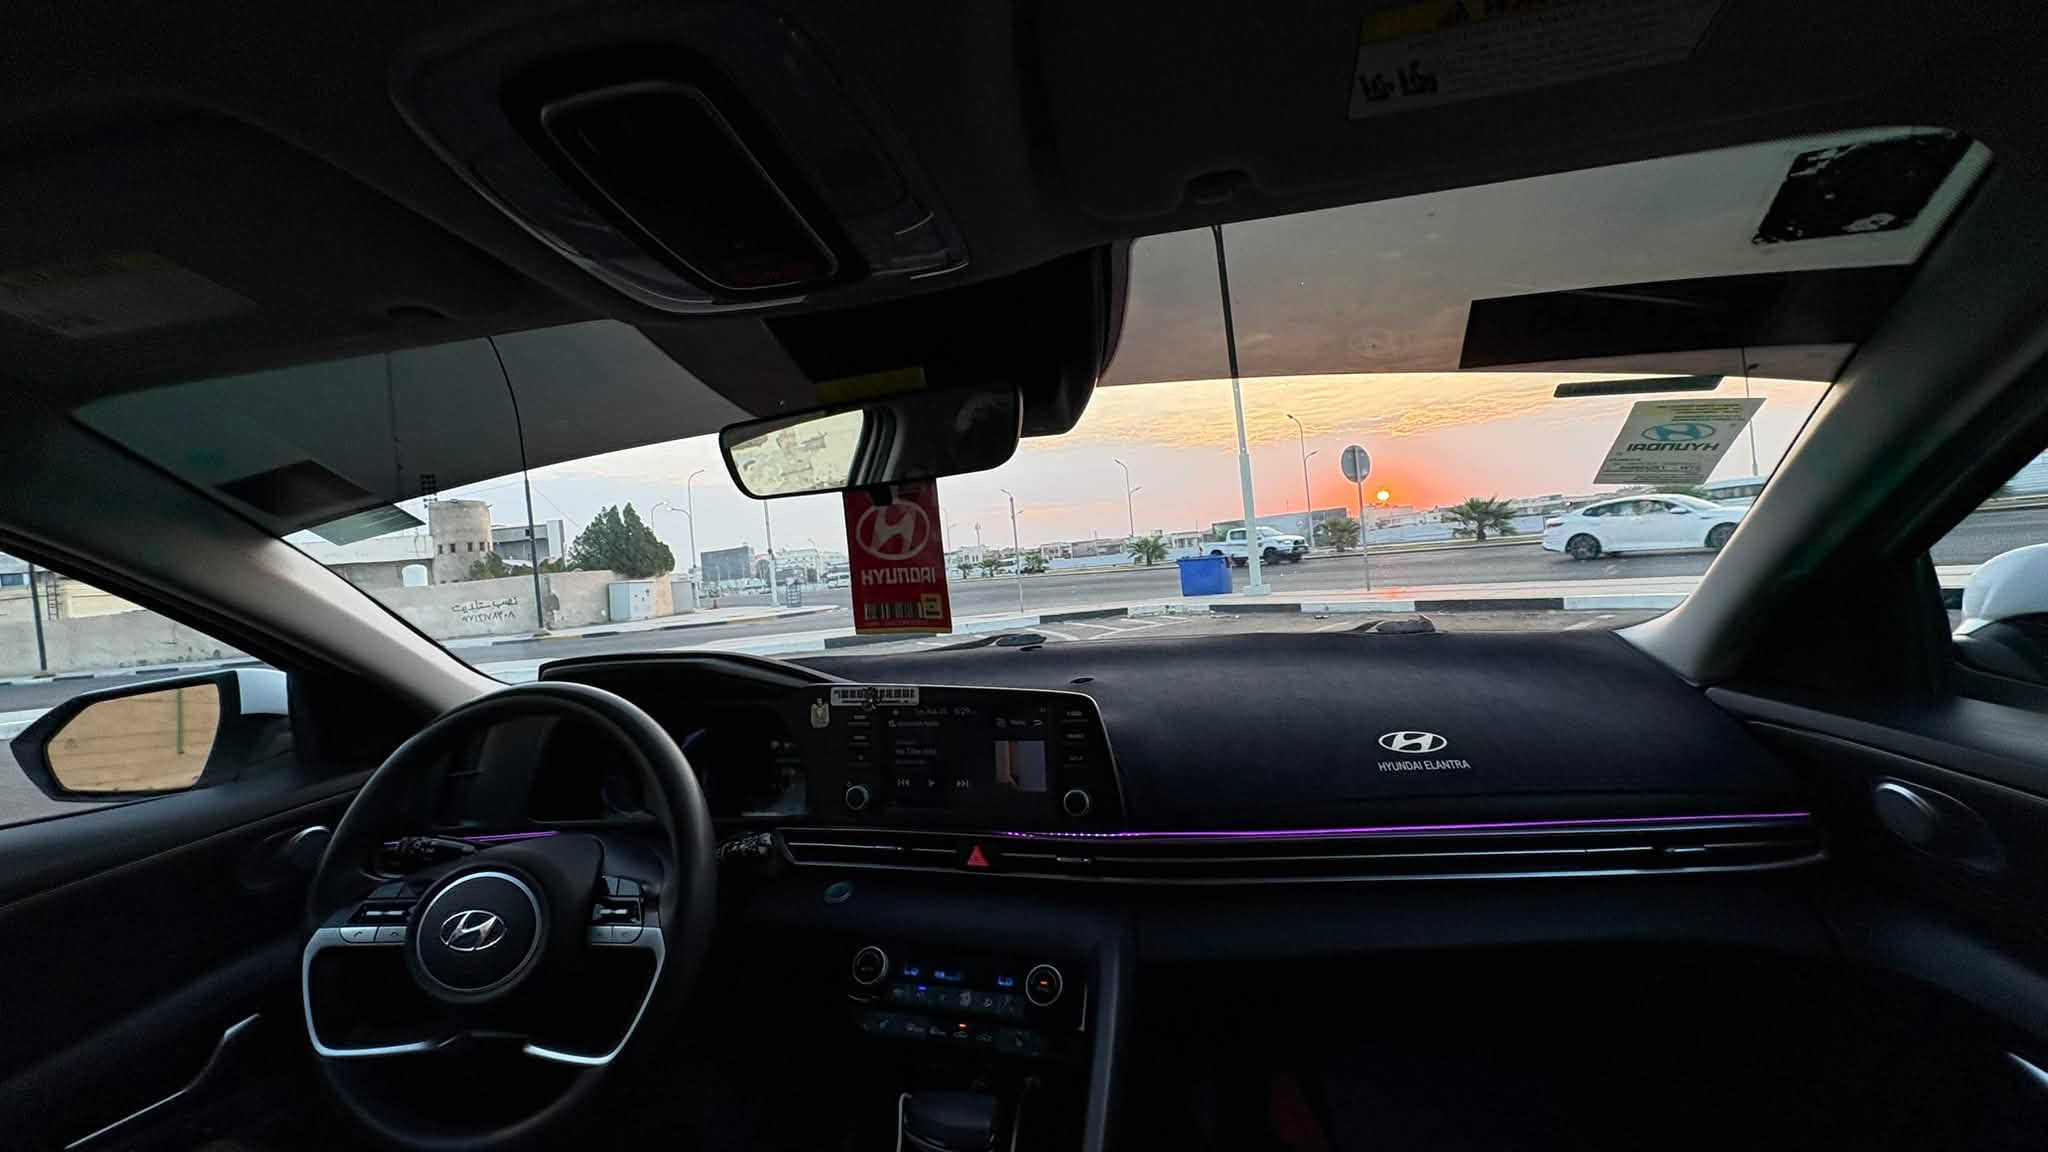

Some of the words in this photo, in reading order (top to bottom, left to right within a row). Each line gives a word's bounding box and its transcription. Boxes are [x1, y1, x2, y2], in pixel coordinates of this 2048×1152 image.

[861, 567, 936, 585] HYUNDAI
[1378, 761, 1422, 771] HYUNDAI
[1423, 759, 1471, 769] ELANTRA
